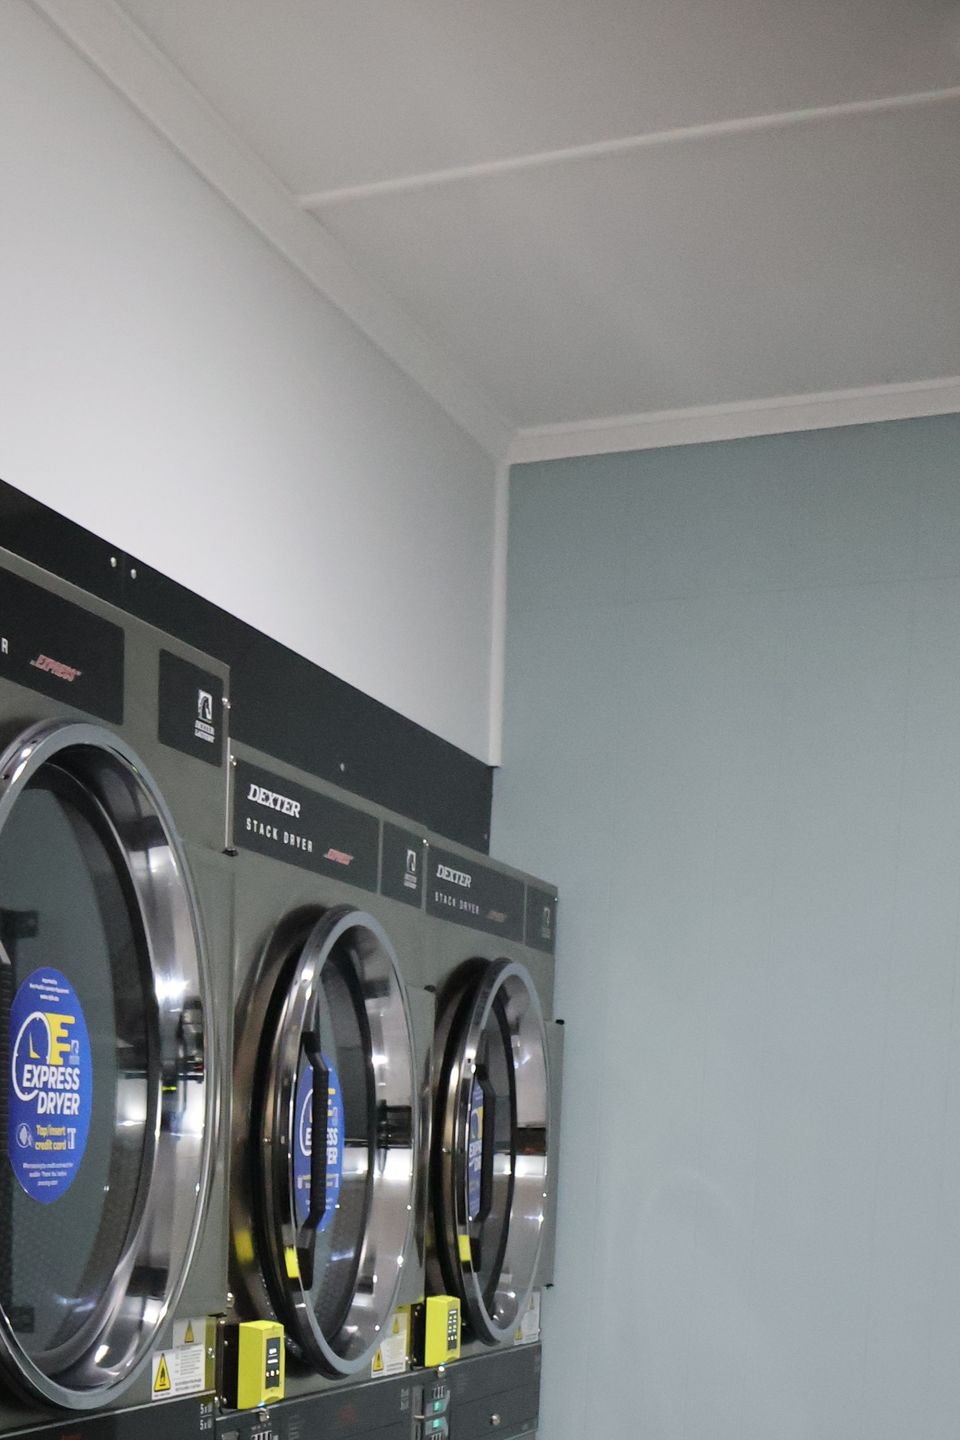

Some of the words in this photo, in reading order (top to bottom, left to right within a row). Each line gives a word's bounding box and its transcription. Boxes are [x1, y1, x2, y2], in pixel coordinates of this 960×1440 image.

[247, 783, 301, 818] DEXTER
[246, 817, 278, 840] STACK
[283, 831, 313, 853] DRYER
[436, 864, 472, 888] DEXTER
[22, 1065, 81, 1091] EXPRESS
[37, 1090, 80, 1115] DRYER
